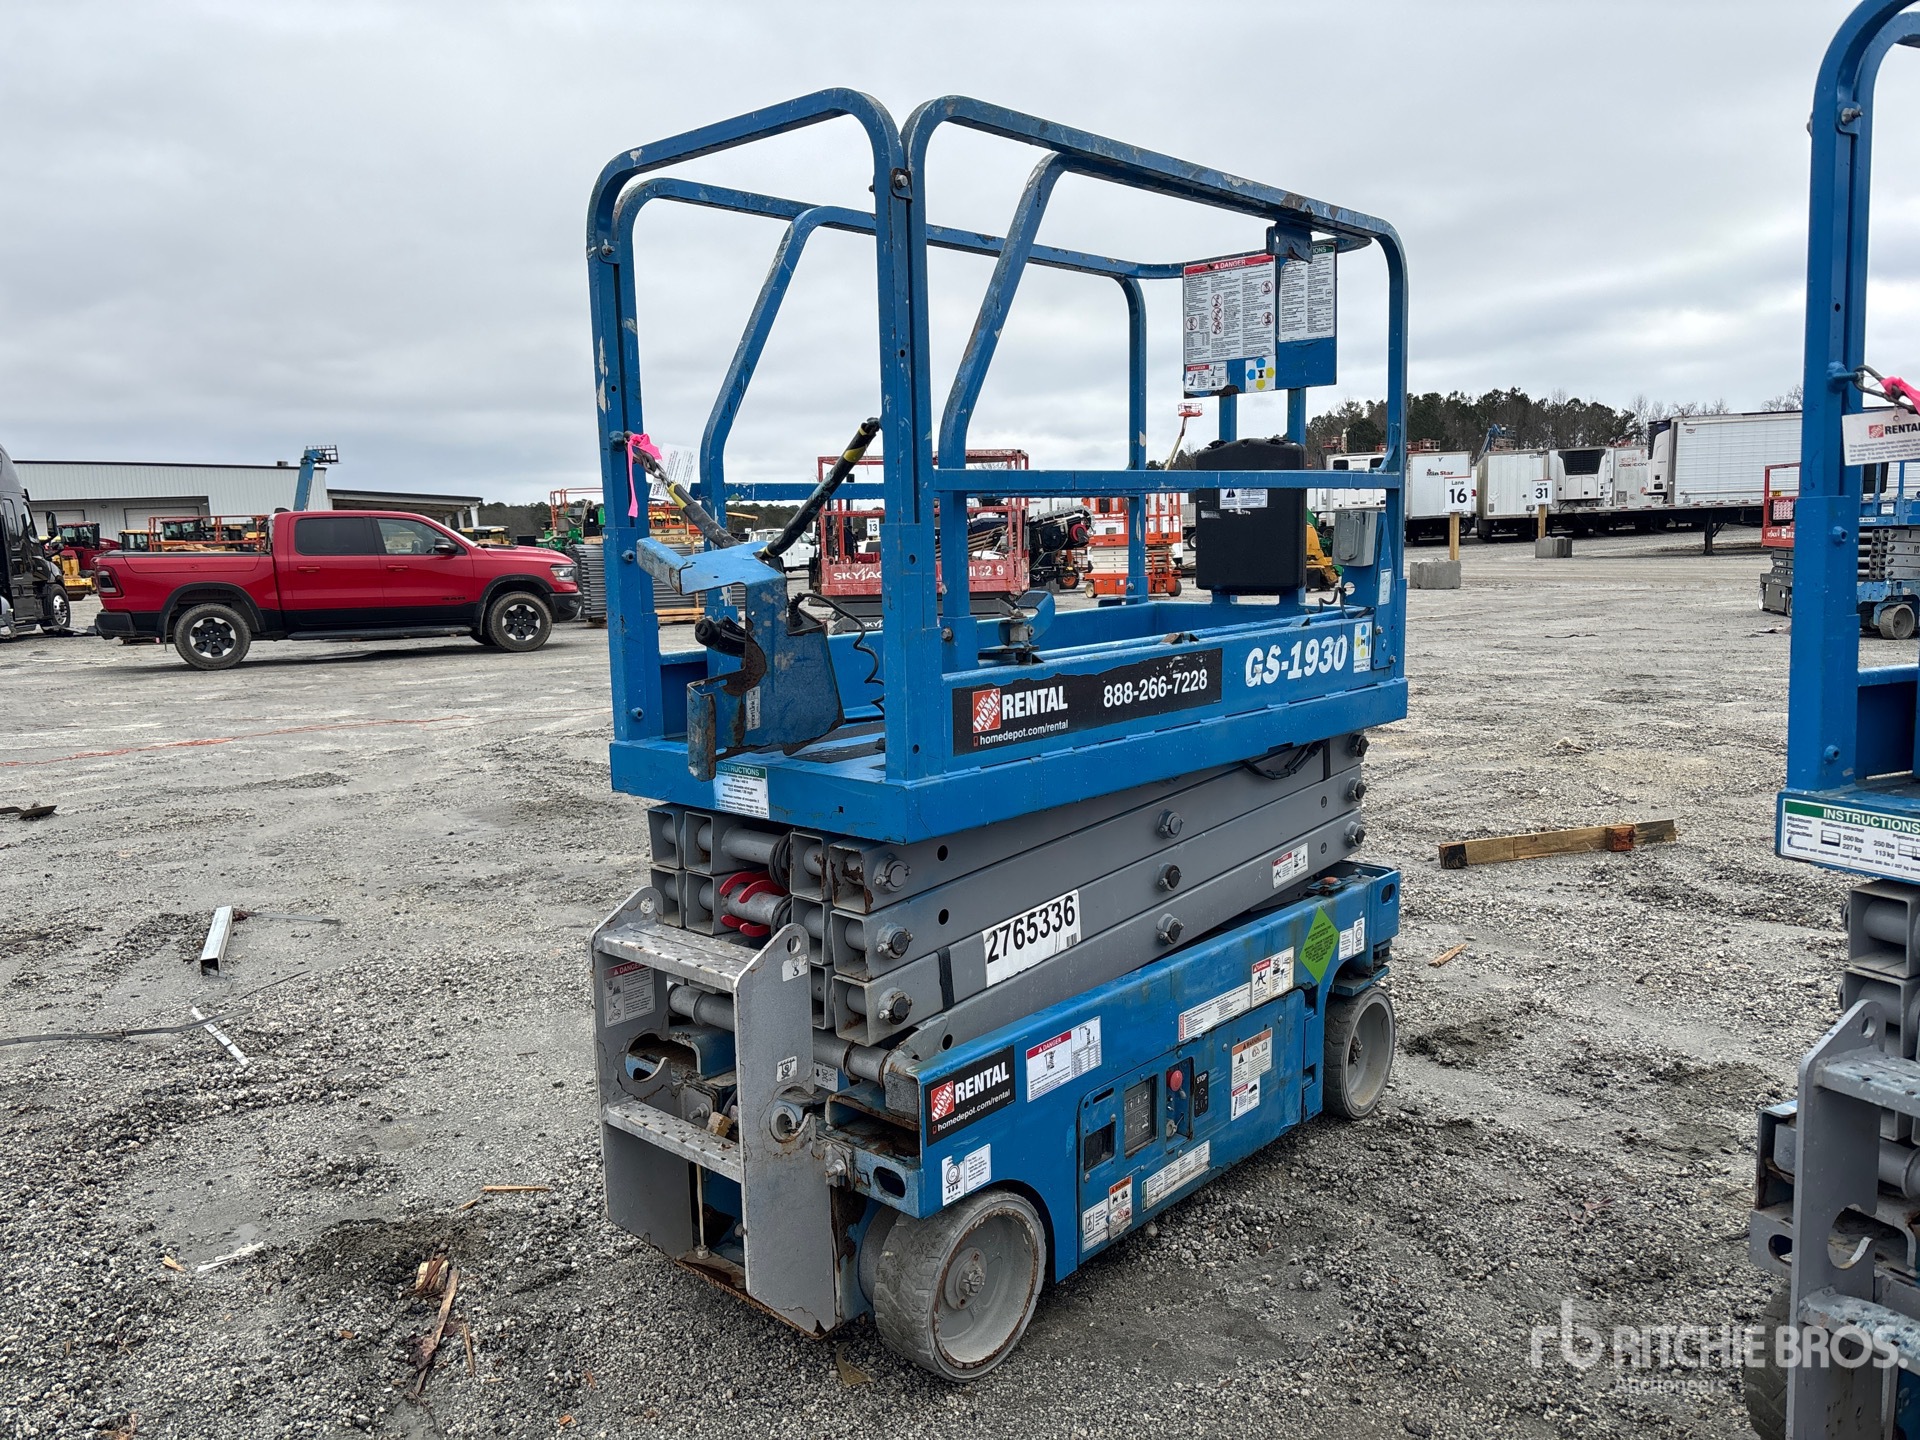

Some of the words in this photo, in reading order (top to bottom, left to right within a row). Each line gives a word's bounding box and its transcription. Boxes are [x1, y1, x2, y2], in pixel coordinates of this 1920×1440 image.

[1220, 260, 1246, 268] DANGER
[1449, 488, 1467, 503] 16
[1535, 488, 1548, 499] 31
[834, 568, 882, 582] SKYJAC
[1246, 634, 1348, 688] GS-1930
[1104, 668, 1208, 708] 888-266-7228
[976, 695, 988, 712] THE
[1002, 686, 1068, 720] RENTAL
[974, 690, 1000, 731] HOME
[980, 719, 1068, 746] homedepot.com/rental
[1787, 816, 1812, 824] Maximum
[1787, 822, 1809, 830] Platform
[1821, 821, 1841, 830] Platform
[1823, 808, 1920, 833] INSTRUCTIONS
[1786, 829, 1812, 838] Capacities
[1854, 836, 1864, 844] lbs
[1854, 845, 1862, 853] kg
[1874, 840, 1884, 848] 250
[1885, 842, 1895, 850] lbs
[1886, 851, 1895, 860] kg
[987, 895, 1075, 964] 2765336
[1043, 1037, 1062, 1050] DANGER
[955, 1062, 1010, 1104] RENTAL
[1197, 1073, 1207, 1084] STOP
[932, 1083, 953, 1119] HOME
[938, 1088, 1010, 1131] homedepot.com/rental
